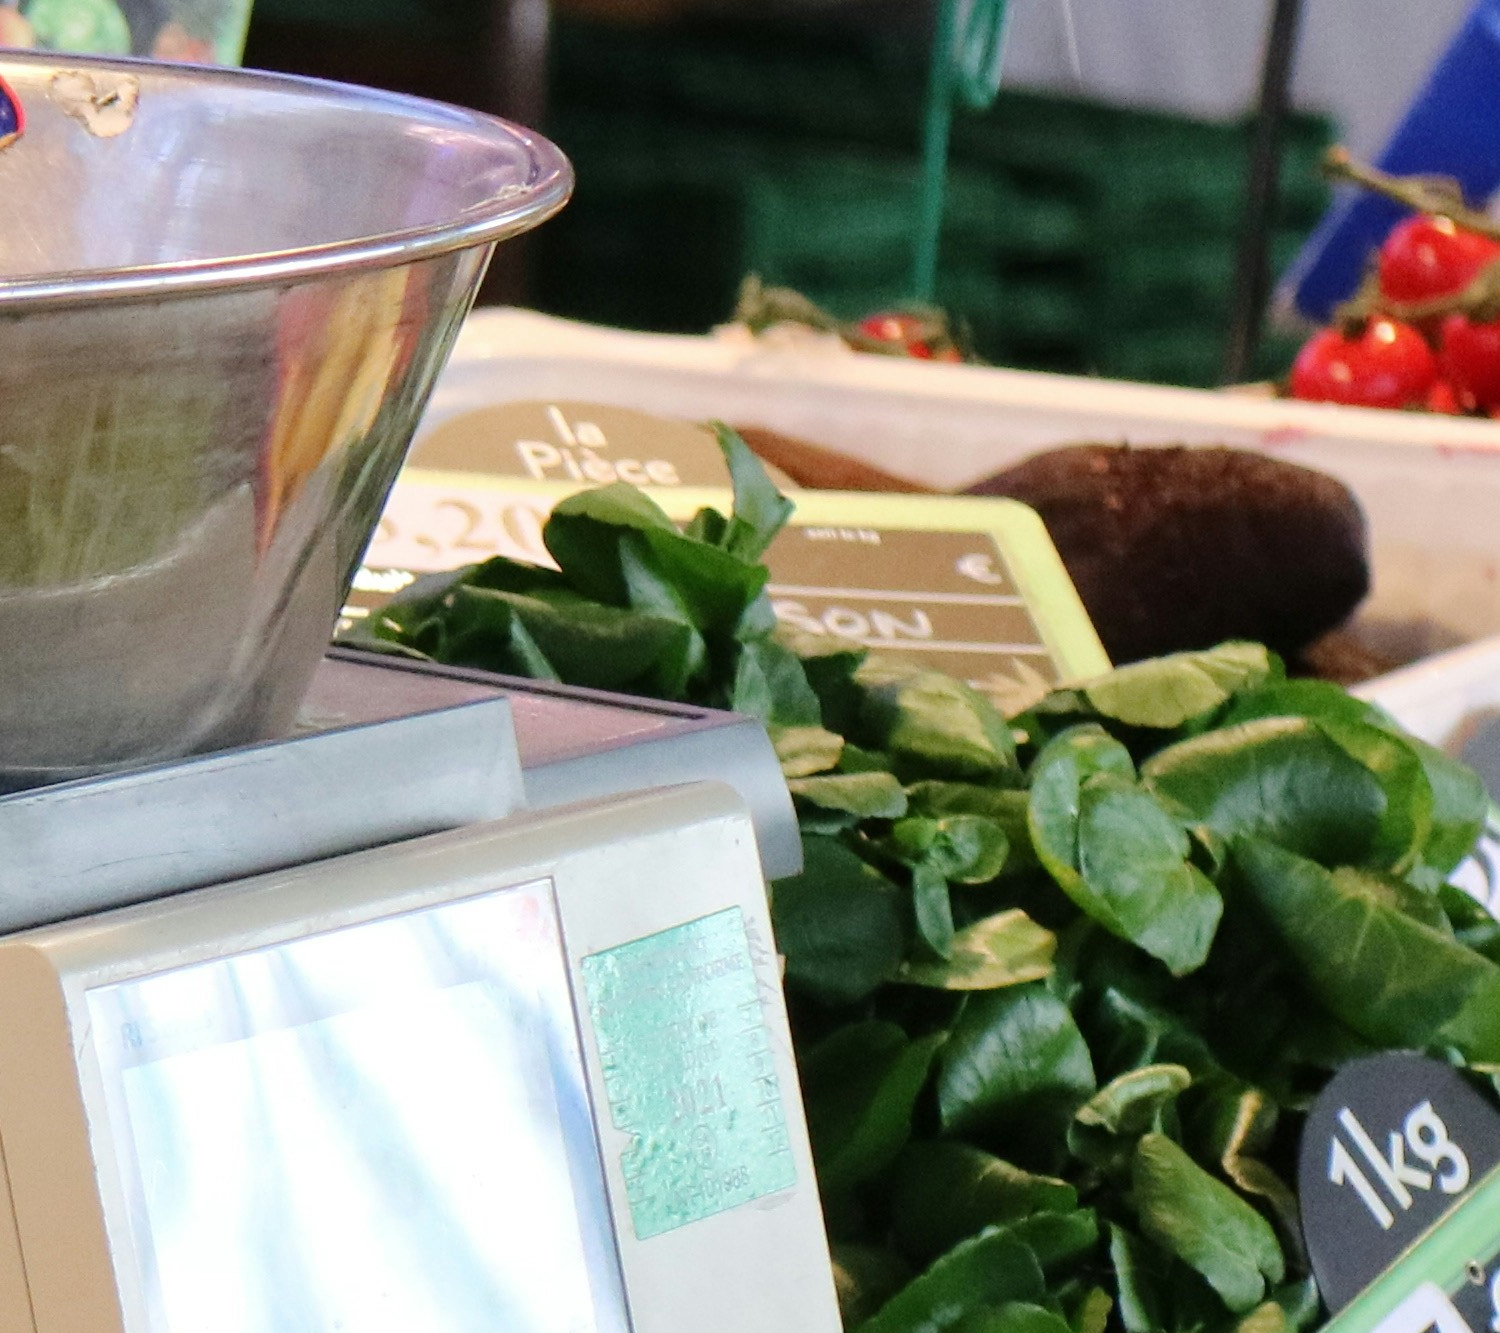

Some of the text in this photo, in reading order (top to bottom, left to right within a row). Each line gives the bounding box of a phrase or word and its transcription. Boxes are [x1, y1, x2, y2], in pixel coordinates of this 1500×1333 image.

[547, 404, 609, 448] la
[514, 438, 681, 486] Pièce
[1327, 1100, 1471, 1231] 1kg
